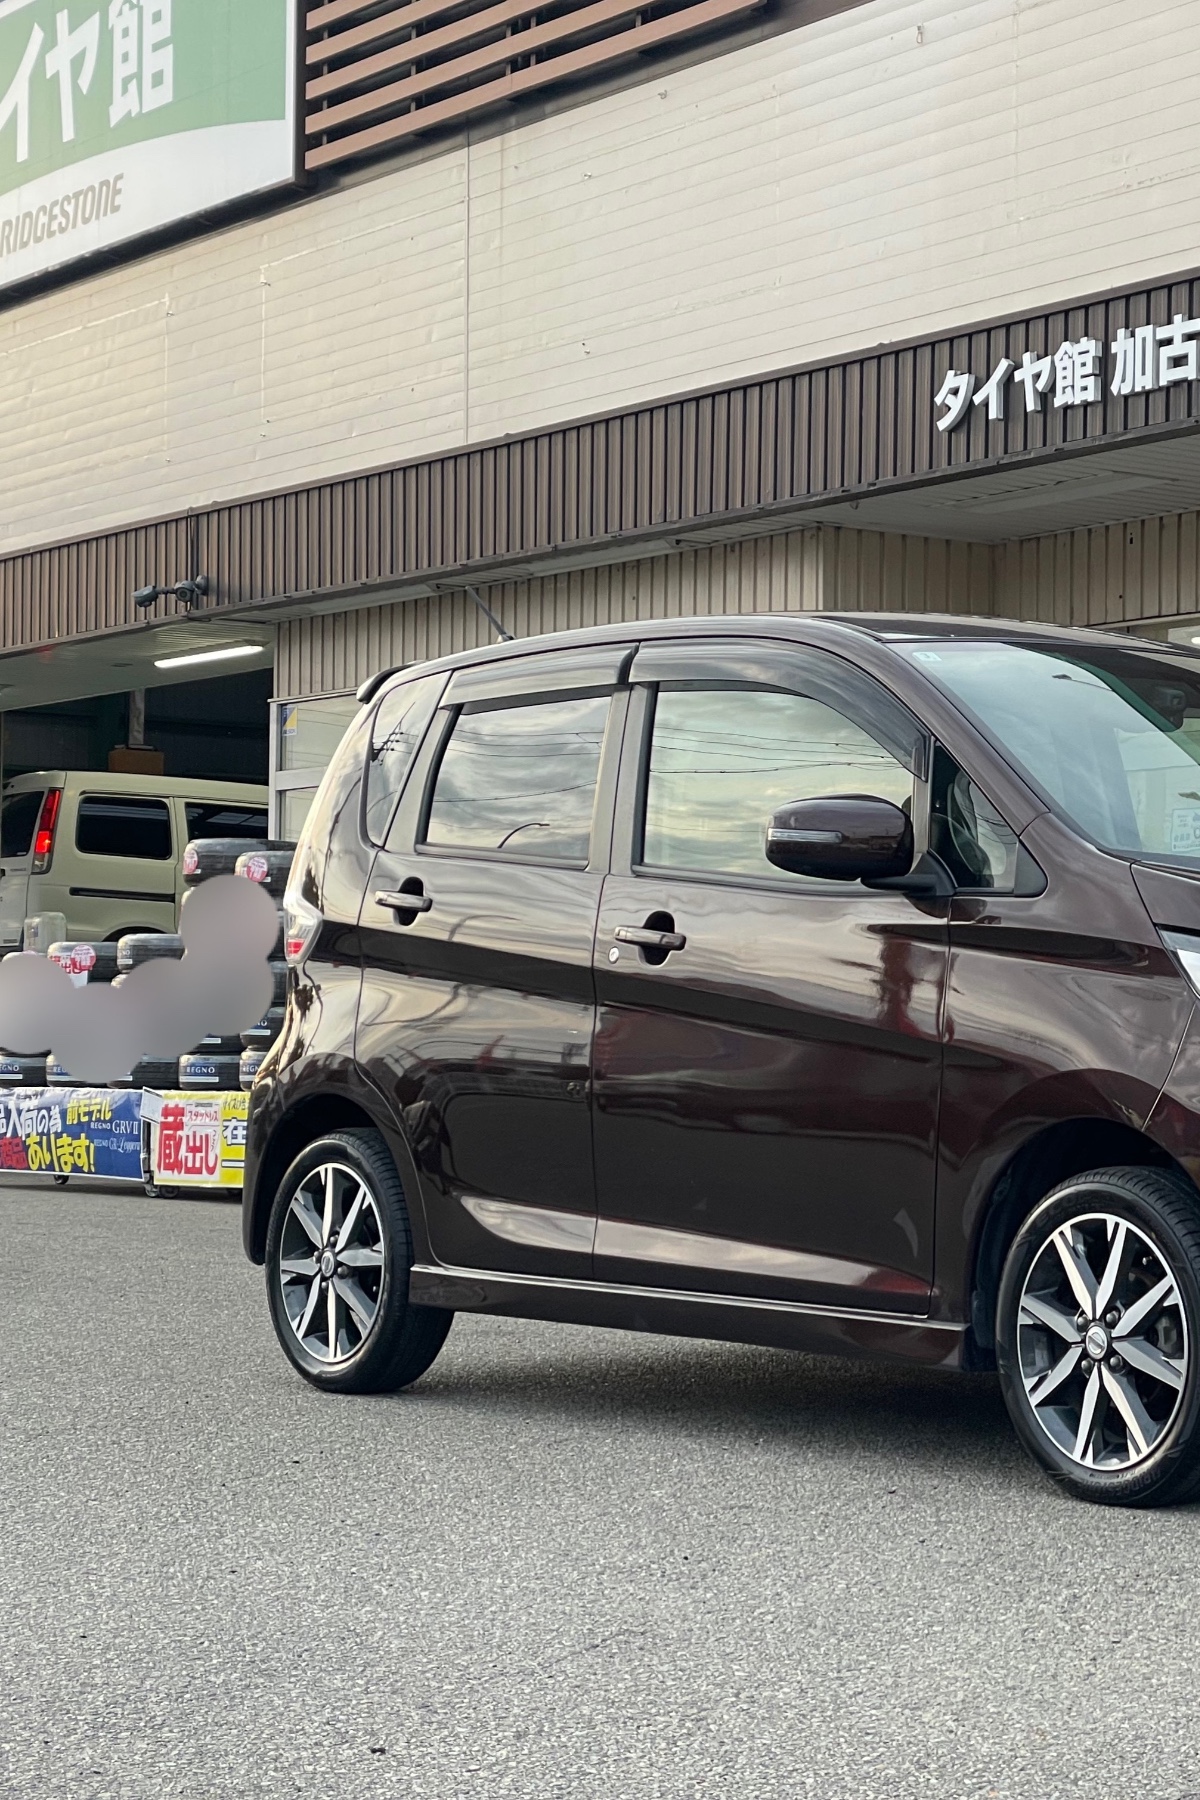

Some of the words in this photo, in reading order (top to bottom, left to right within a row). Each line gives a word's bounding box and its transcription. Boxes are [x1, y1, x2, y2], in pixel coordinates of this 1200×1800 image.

[934, 336, 1102, 433] タイヤ館
[67, 1097, 112, 1125] 前モデル
[26, 1133, 95, 1173] あります!
[157, 1104, 218, 1176] 蔵出し
